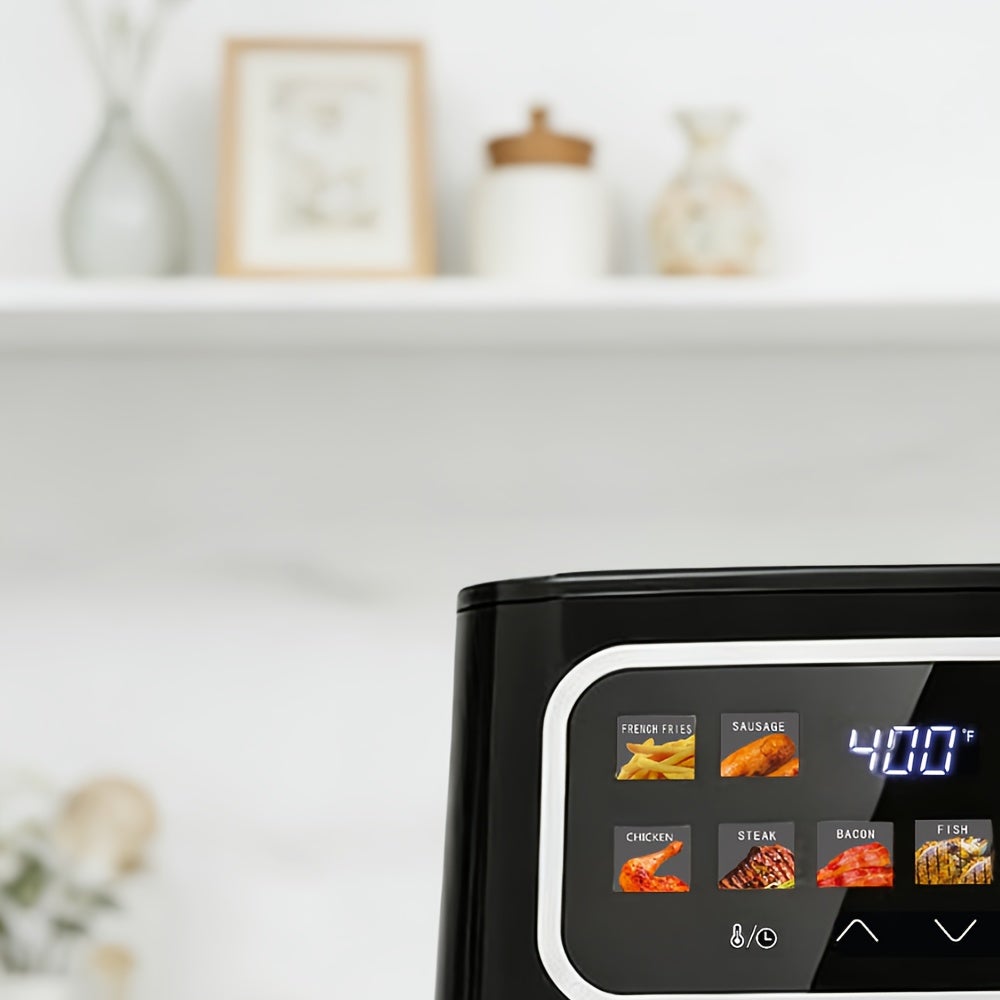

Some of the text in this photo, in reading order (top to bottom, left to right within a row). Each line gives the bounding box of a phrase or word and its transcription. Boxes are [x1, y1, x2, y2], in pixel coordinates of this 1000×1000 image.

[621, 723, 692, 734] FRENCH FRIES
[732, 721, 785, 732] SAUSAGE
[849, 726, 956, 775] 400
[836, 829, 875, 839] BACON
[937, 824, 968, 835] FISH
[626, 832, 674, 842] CHICKEN
[737, 830, 776, 841] STEAK
